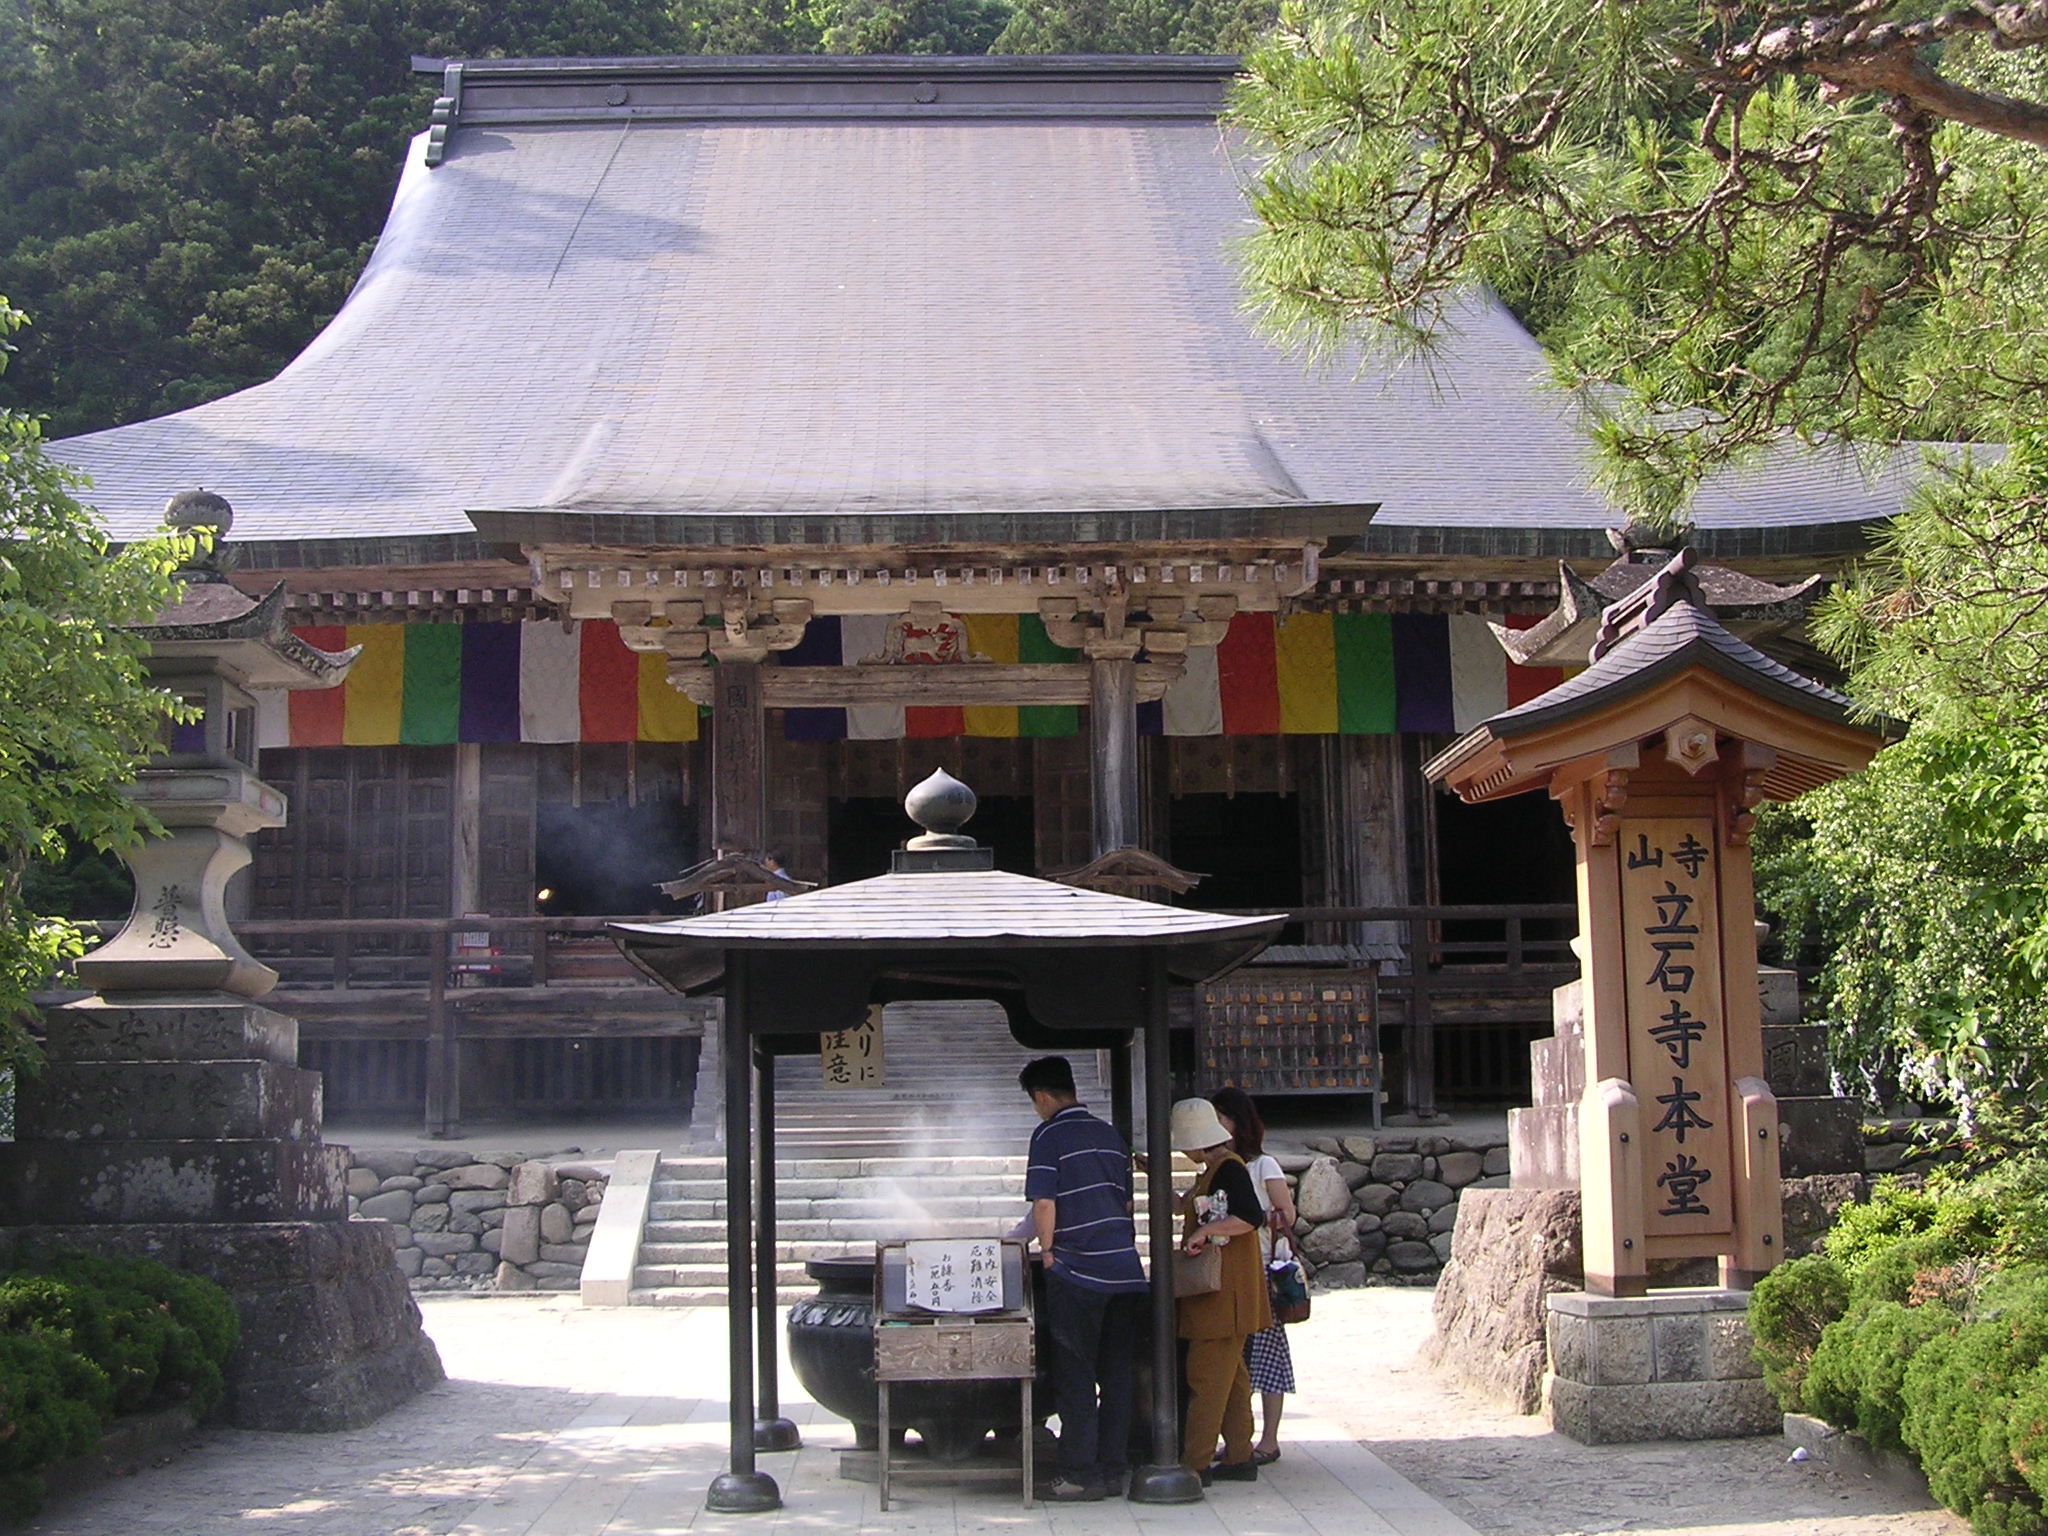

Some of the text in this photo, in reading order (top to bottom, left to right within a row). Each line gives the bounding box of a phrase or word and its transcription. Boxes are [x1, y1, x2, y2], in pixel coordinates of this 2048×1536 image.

[1626, 832, 1710, 880] 山寺
[825, 1031, 851, 1083] 注意
[1643, 881, 1714, 1218] 立石寺本堂
[940, 1253, 956, 1292] お線香
[984, 1245, 998, 1302] 家内安全
